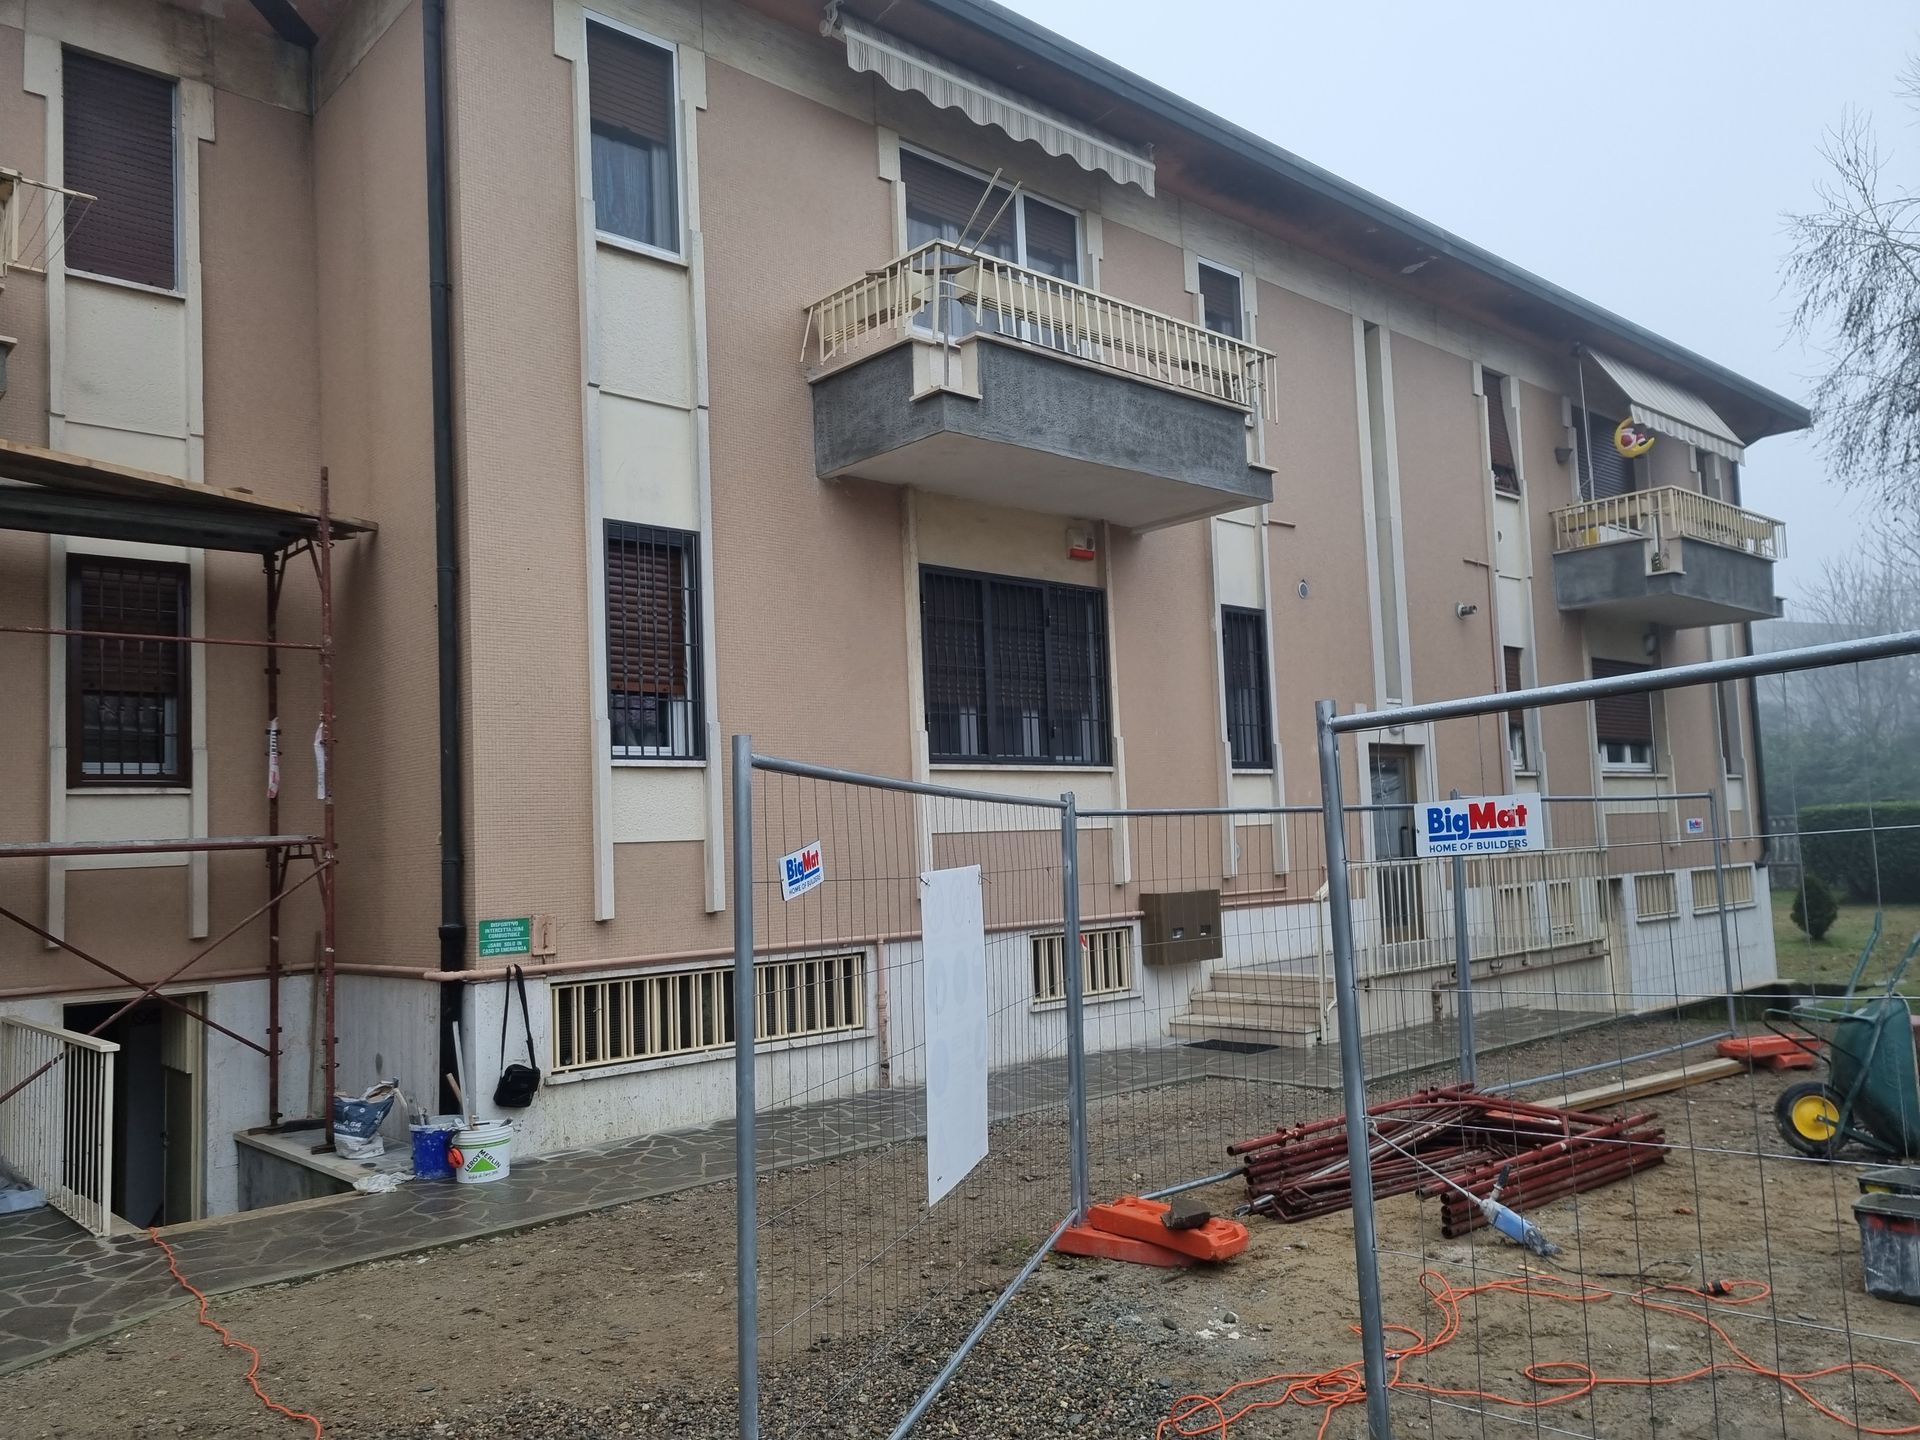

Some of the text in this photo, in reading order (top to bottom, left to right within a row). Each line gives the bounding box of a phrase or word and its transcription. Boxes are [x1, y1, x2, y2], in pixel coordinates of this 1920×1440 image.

[1427, 802, 1527, 840] BigMat
[1429, 839, 1528, 853] HOME OF BUILDERS
[786, 850, 819, 881] BigMat
[464, 1149, 501, 1172] LEROY MERLIN
